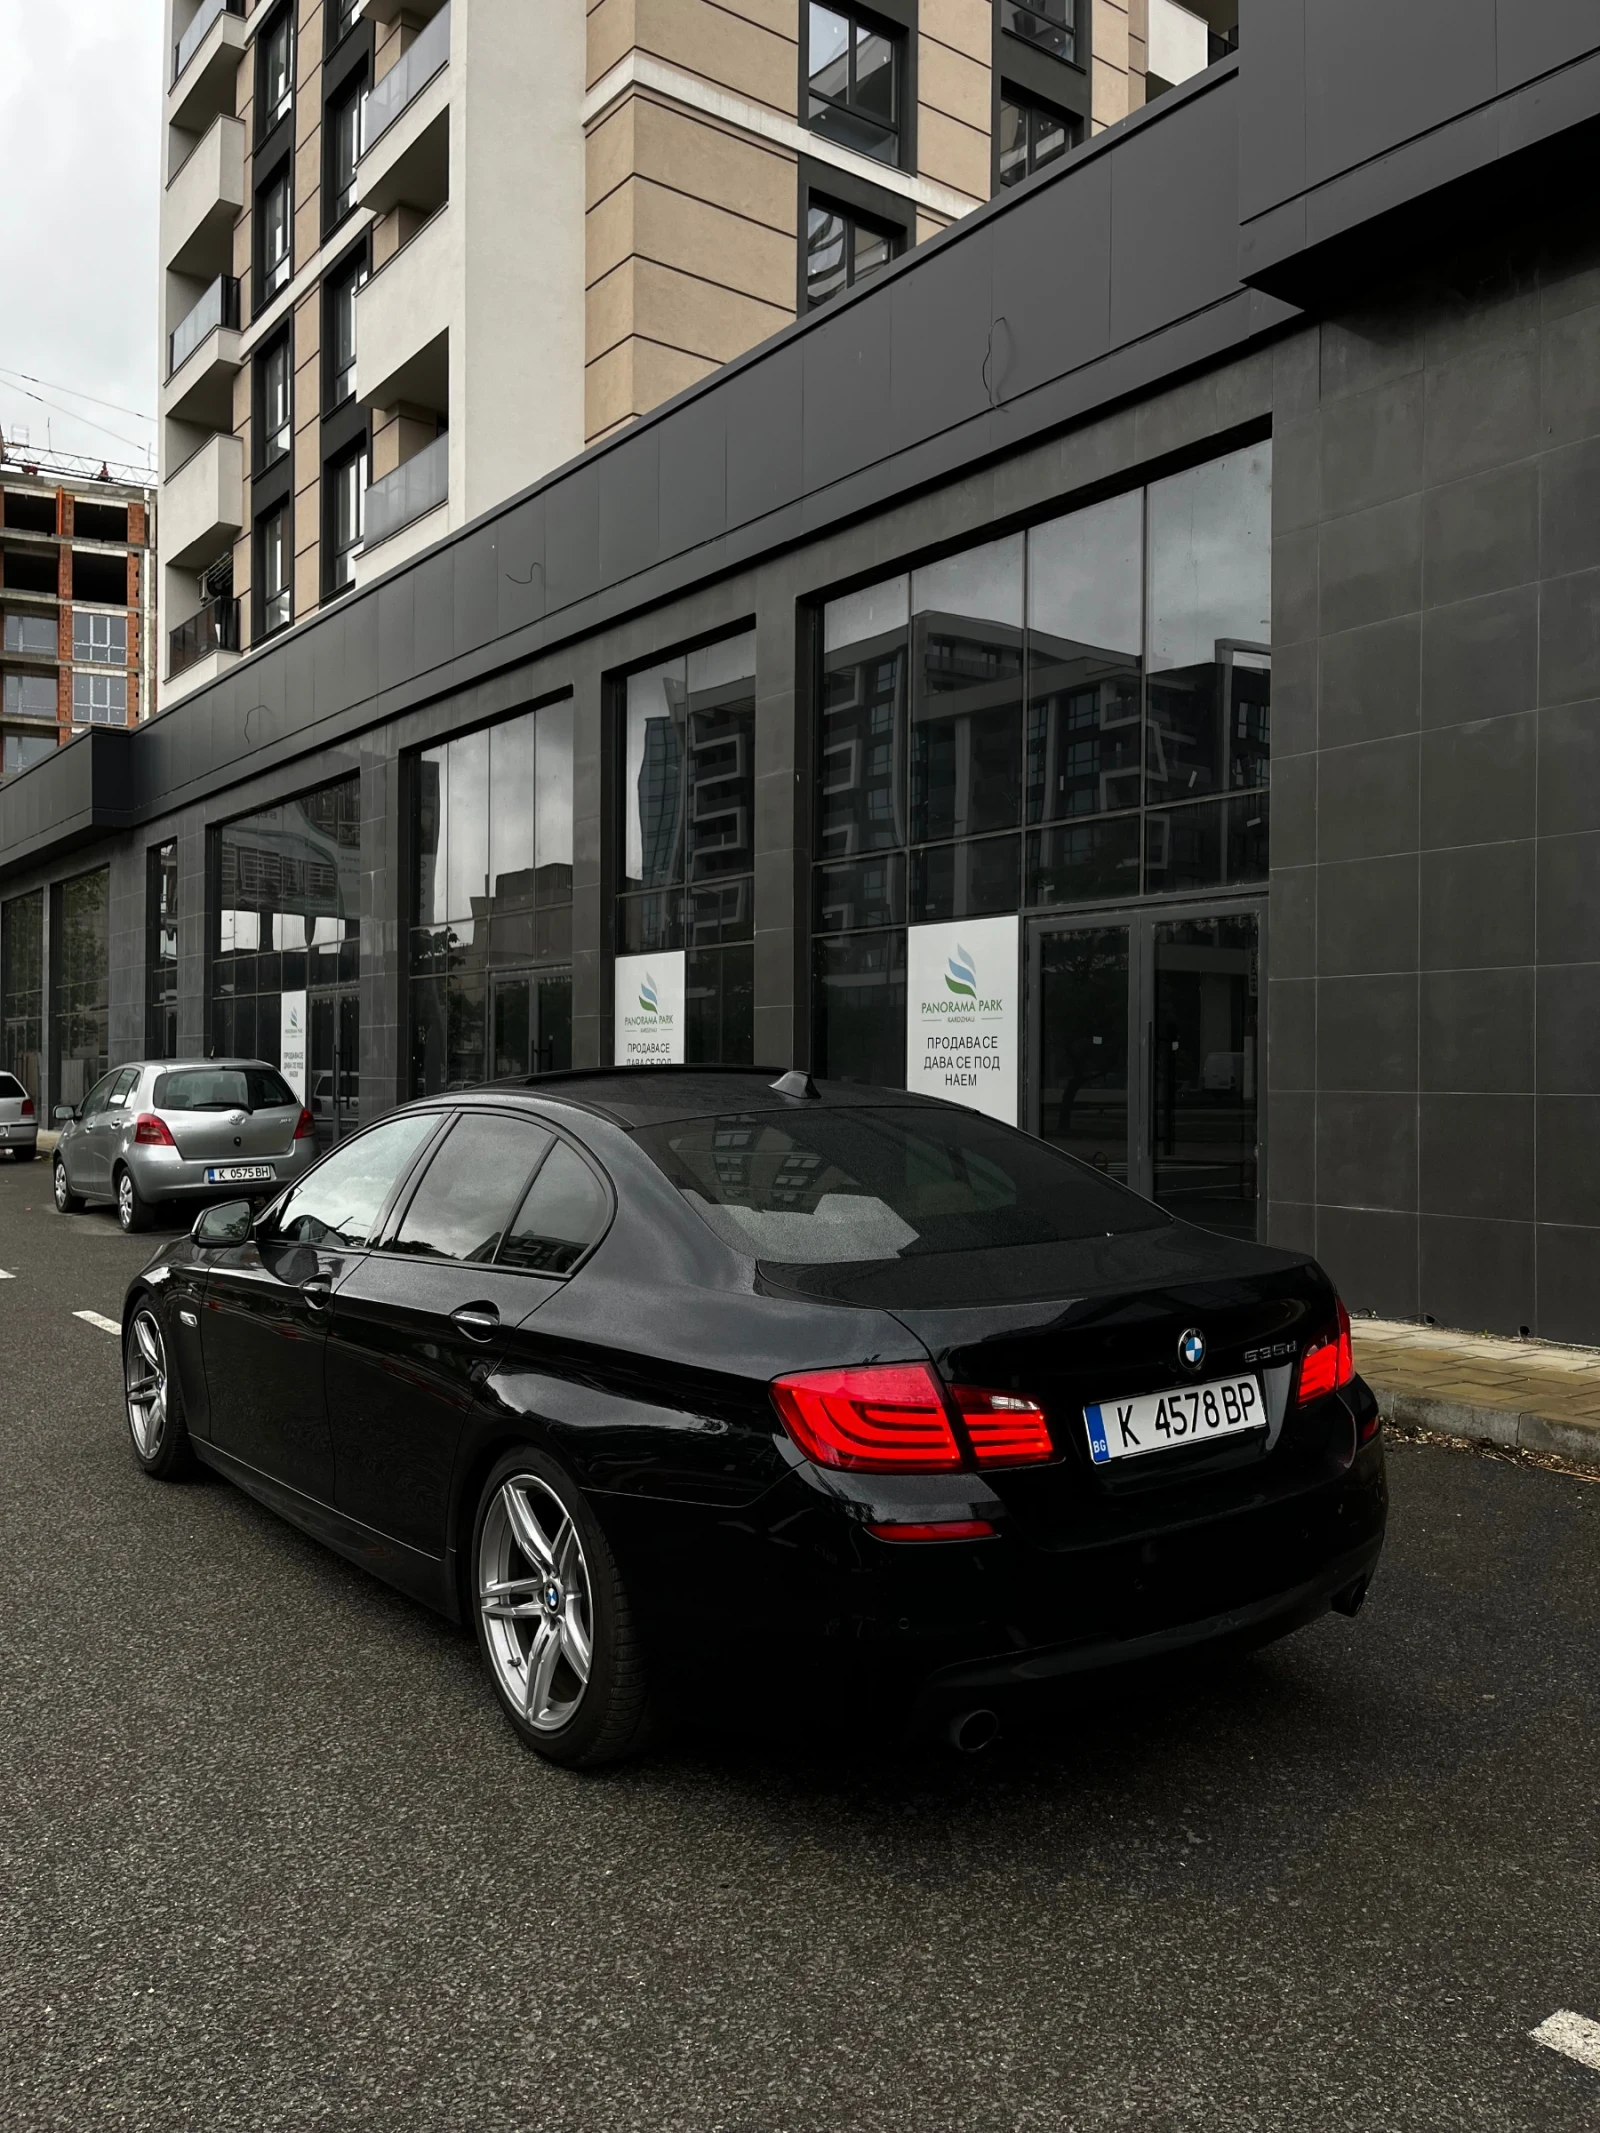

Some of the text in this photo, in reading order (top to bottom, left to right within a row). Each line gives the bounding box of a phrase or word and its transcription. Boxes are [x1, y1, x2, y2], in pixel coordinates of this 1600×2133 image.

[921, 999, 1003, 1014] PANORAMA PARK
[624, 1015, 674, 1026] PANORAMA PARK
[924, 1056, 1000, 1071] ДАВА СЕ ПОД
[945, 1073, 977, 1086] НАЕМ
[218, 1169, 226, 1179] K
[230, 1167, 254, 1179] 0575
[1244, 1340, 1297, 1363] 535d
[1117, 1404, 1141, 1448] K
[1155, 1390, 1220, 1439] 4578
[1093, 1439, 1106, 1453] BG
